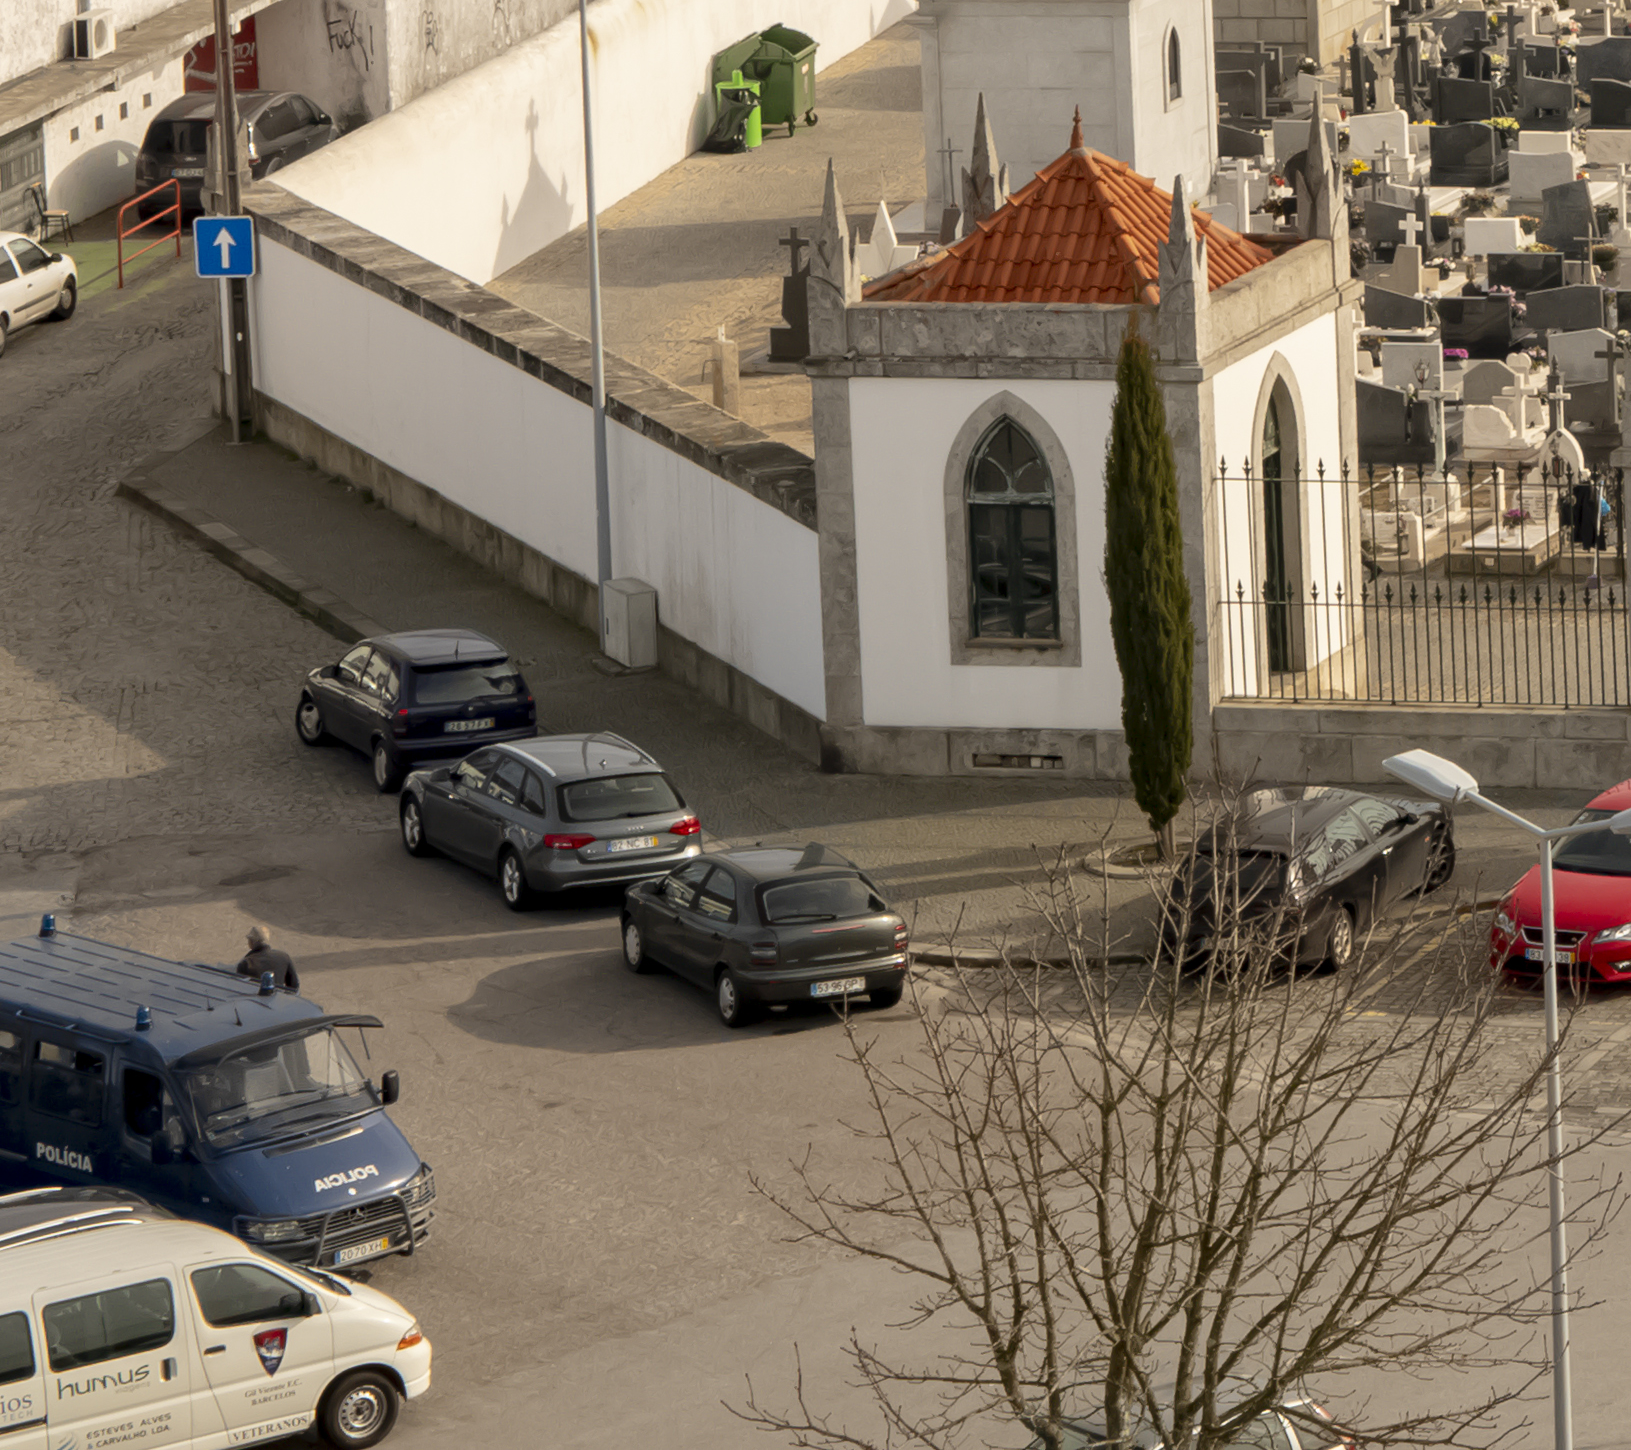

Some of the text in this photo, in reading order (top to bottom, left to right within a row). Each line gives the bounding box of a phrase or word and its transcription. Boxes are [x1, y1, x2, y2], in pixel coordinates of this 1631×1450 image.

[36, 1142, 93, 1173] POLÍCIA
[56, 1363, 150, 1401] humus
[251, 1390, 296, 1406] BARCELOS
[86, 1412, 172, 1440] ESTEVES ALVES
[95, 1429, 148, 1448] CARVALHO
[232, 1415, 308, 1442] VETERANOS
